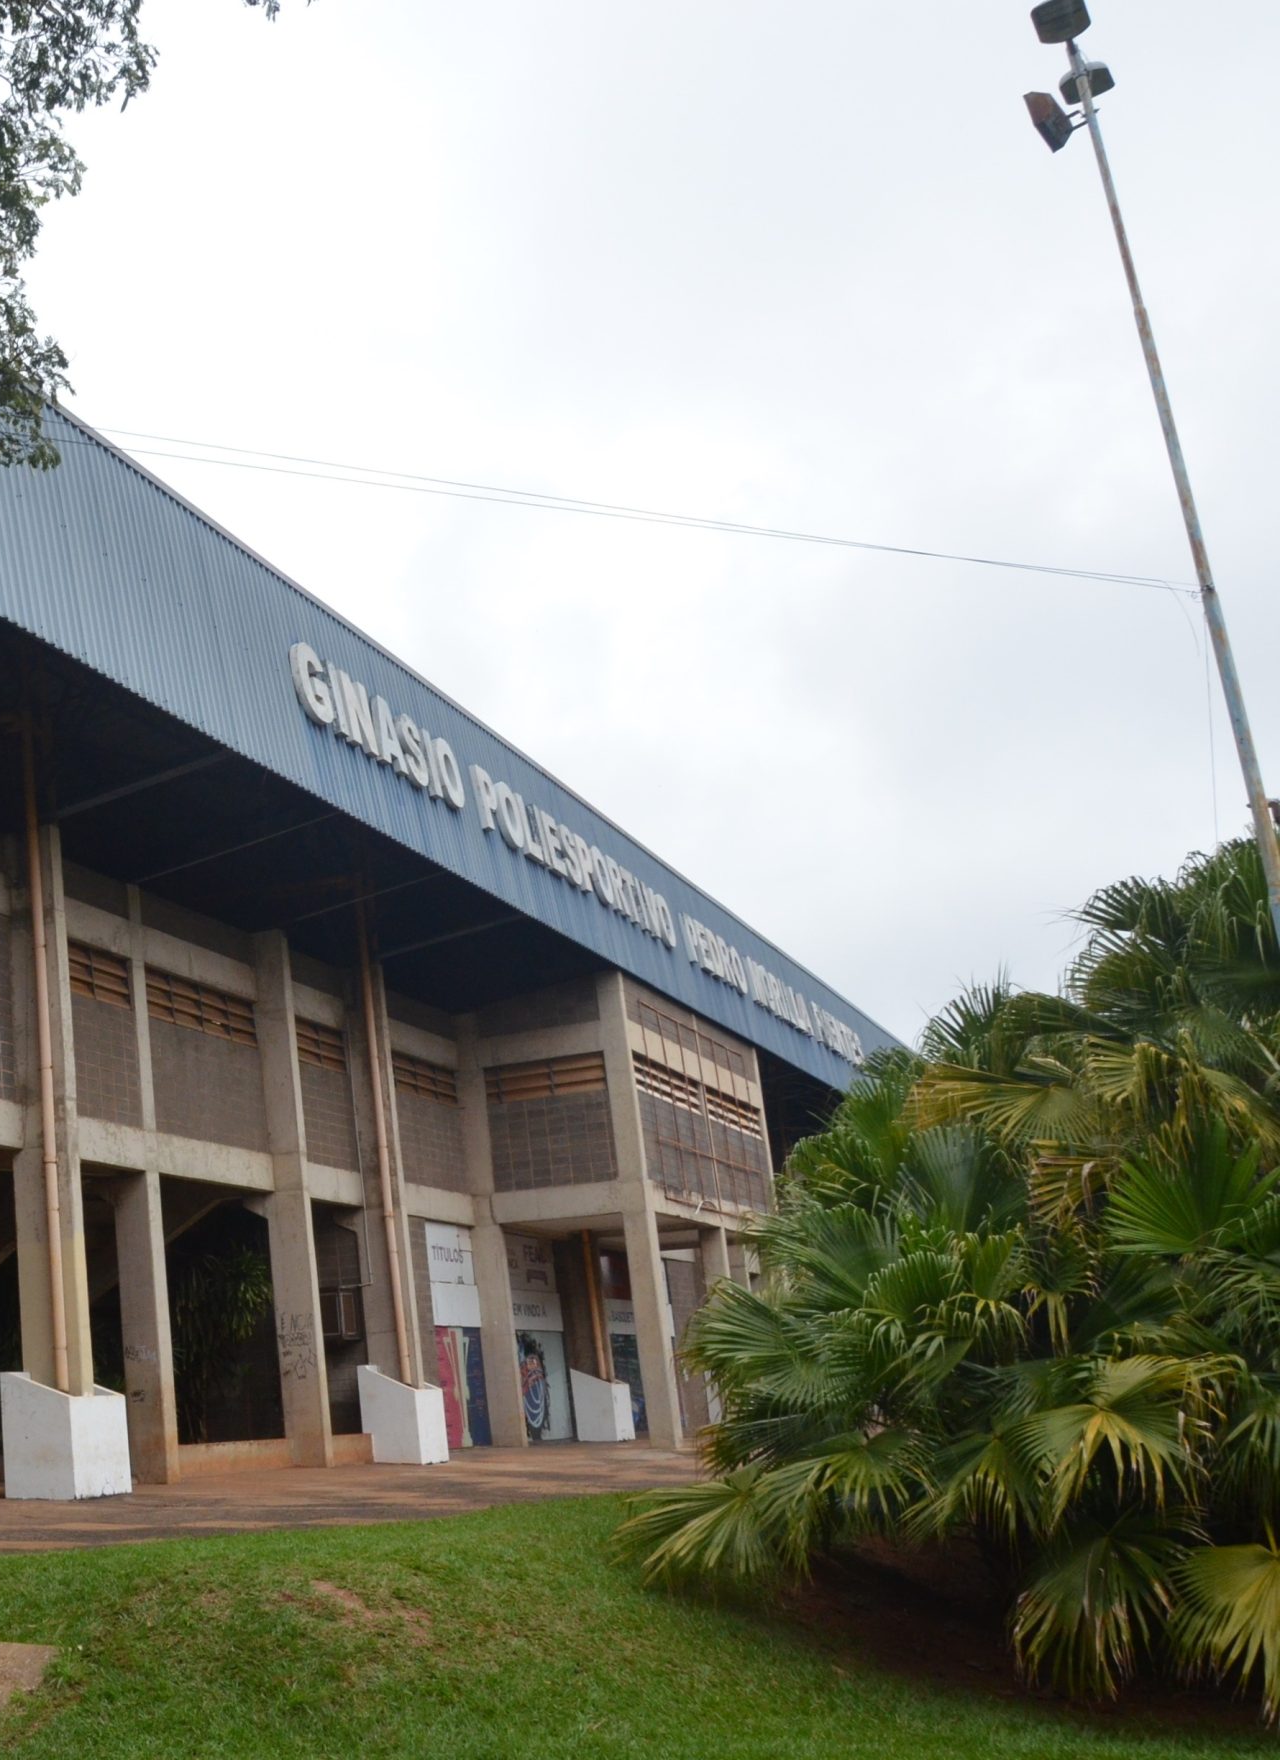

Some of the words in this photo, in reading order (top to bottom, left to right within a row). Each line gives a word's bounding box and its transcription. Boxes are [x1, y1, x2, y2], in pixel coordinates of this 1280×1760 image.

[470, 764, 677, 949] POLIESPORTIVO
[679, 912, 748, 997] PEDRO
[432, 1243, 464, 1264] TÍTULOS
